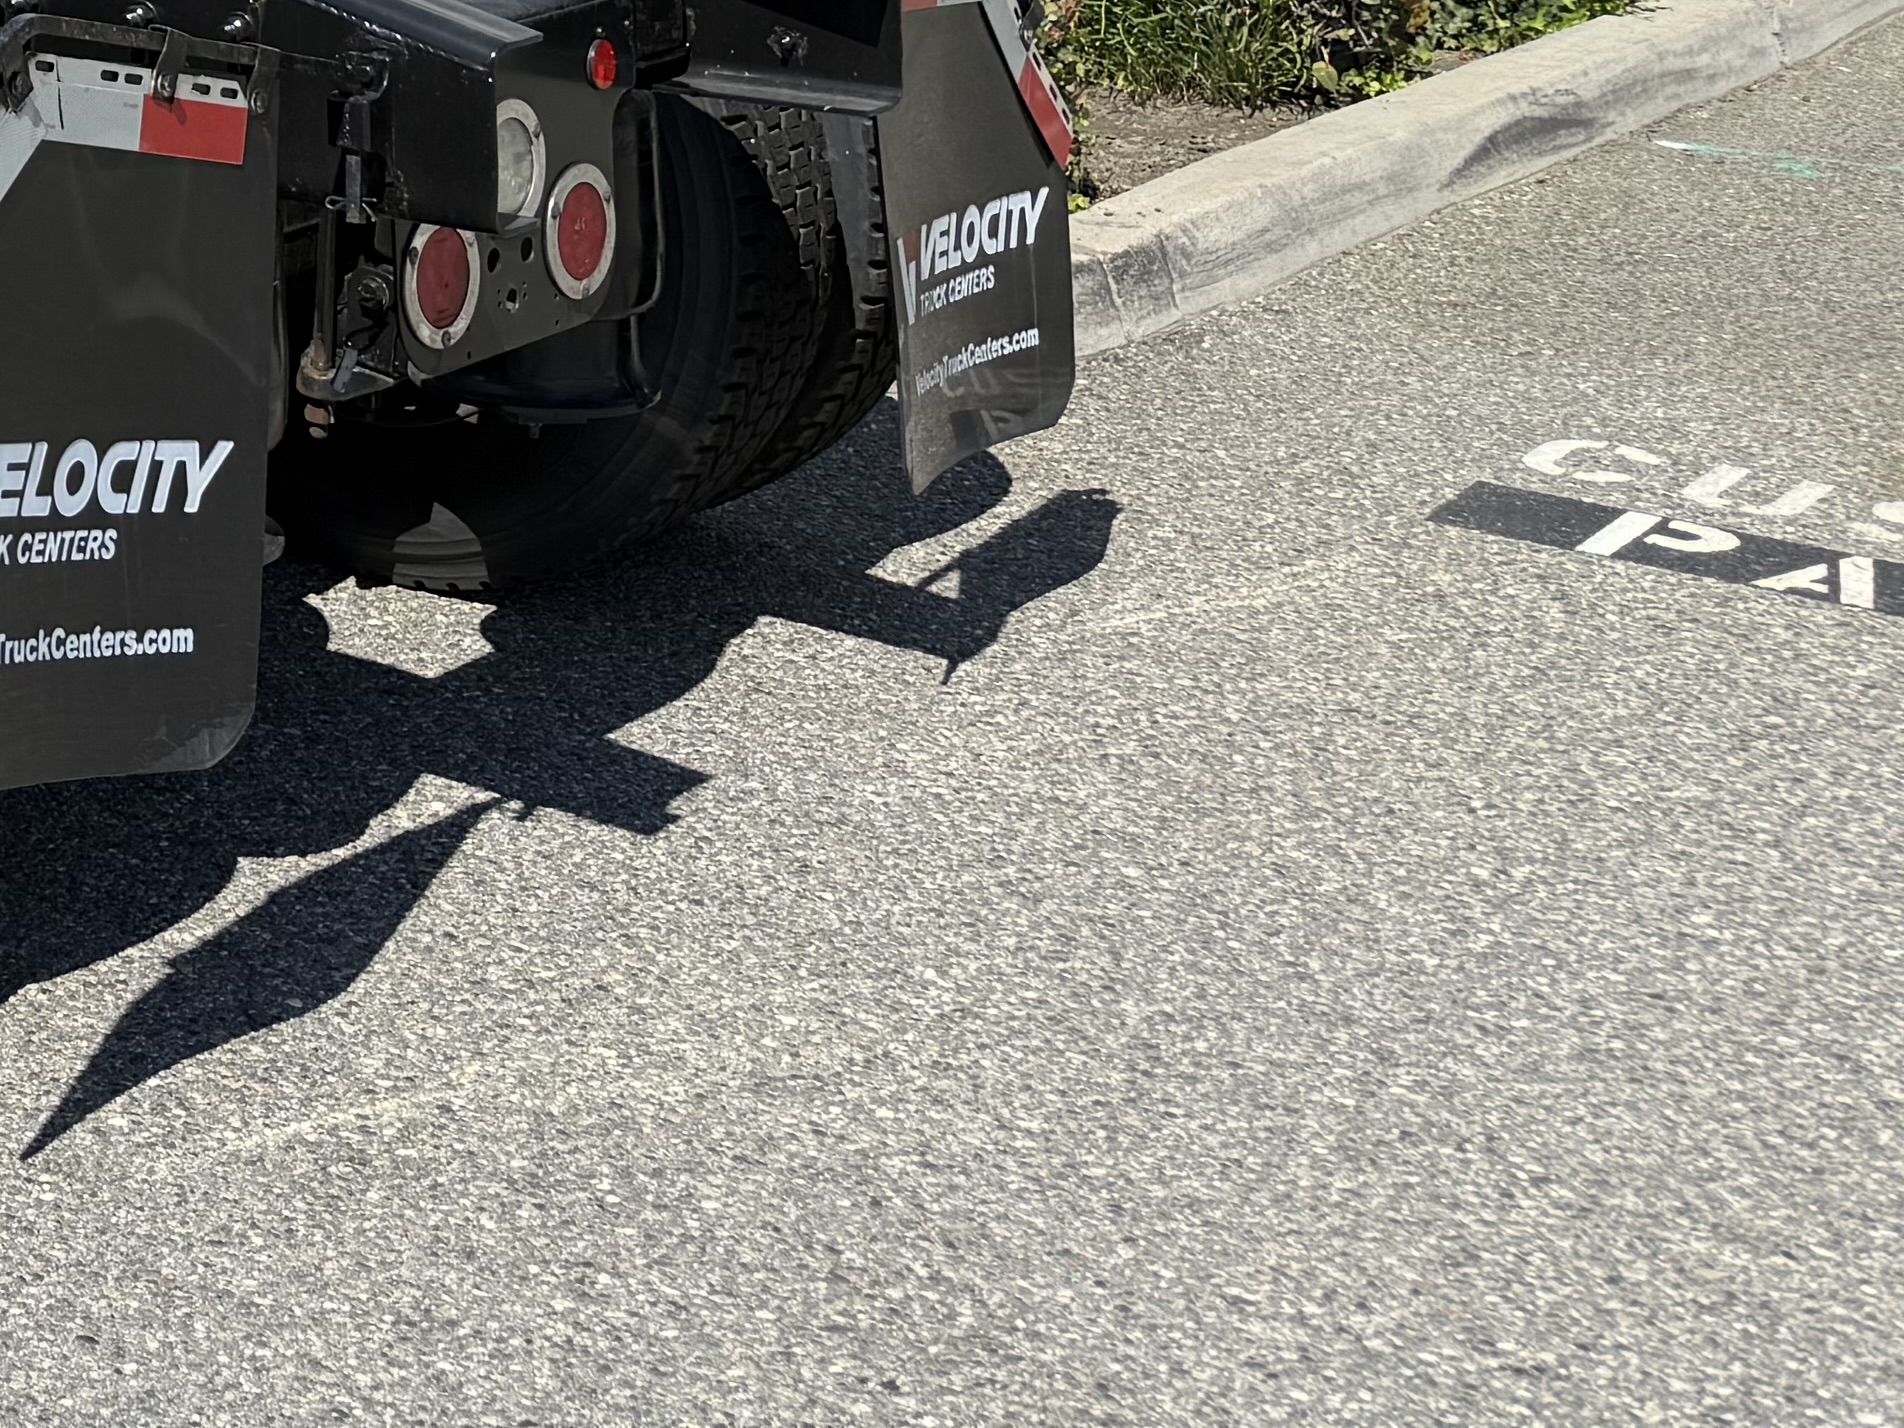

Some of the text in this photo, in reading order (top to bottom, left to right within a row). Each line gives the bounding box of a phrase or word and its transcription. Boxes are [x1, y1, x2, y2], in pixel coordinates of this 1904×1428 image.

[921, 186, 1050, 281] VELOCITY
[948, 265, 995, 303] CENTERS
[915, 327, 1040, 395] VelocityTruckCenters.com
[16, 528, 118, 565] CENTERS
